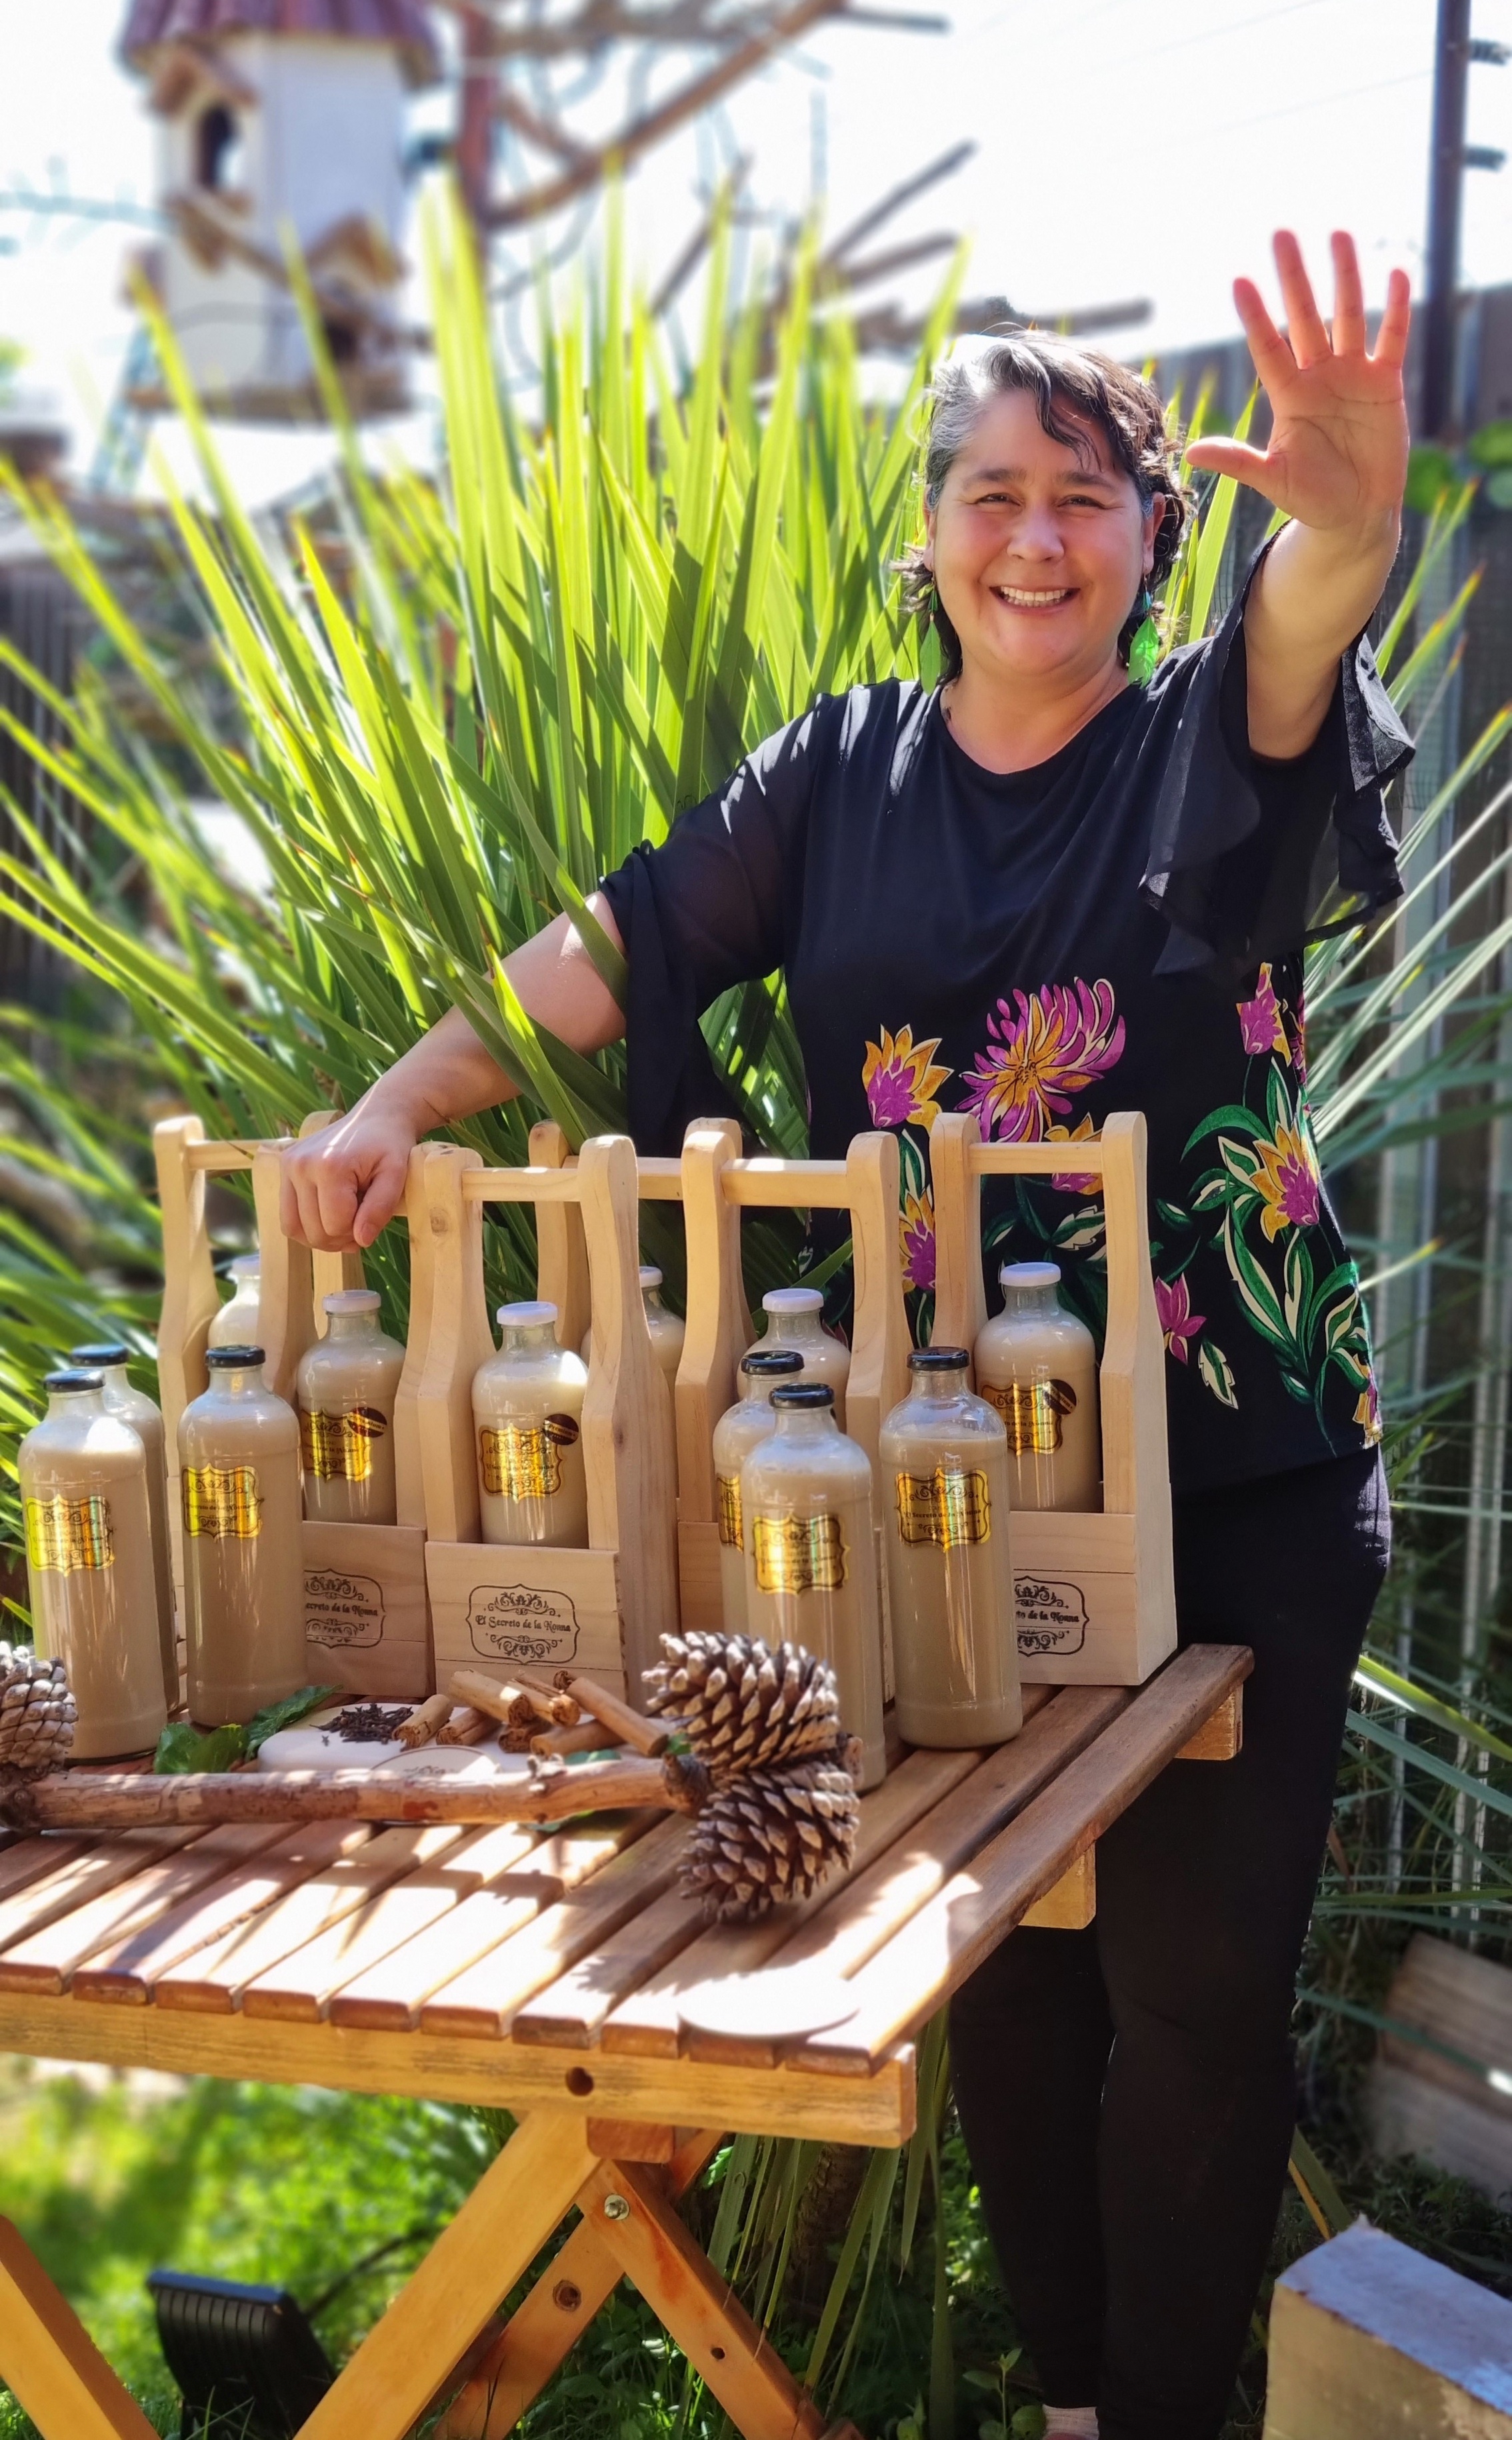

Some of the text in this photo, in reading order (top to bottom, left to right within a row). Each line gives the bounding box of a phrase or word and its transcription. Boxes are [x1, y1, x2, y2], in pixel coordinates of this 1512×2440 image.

[549, 1423, 573, 1436] Premium
[305, 1603, 378, 1617] ecreto de la Nonna
[1027, 1610, 1038, 1620] de
[1039, 1611, 1049, 1620] la
[1050, 1611, 1079, 1624] Nonna
[475, 1615, 571, 1633] El Secreto de la Nonna
